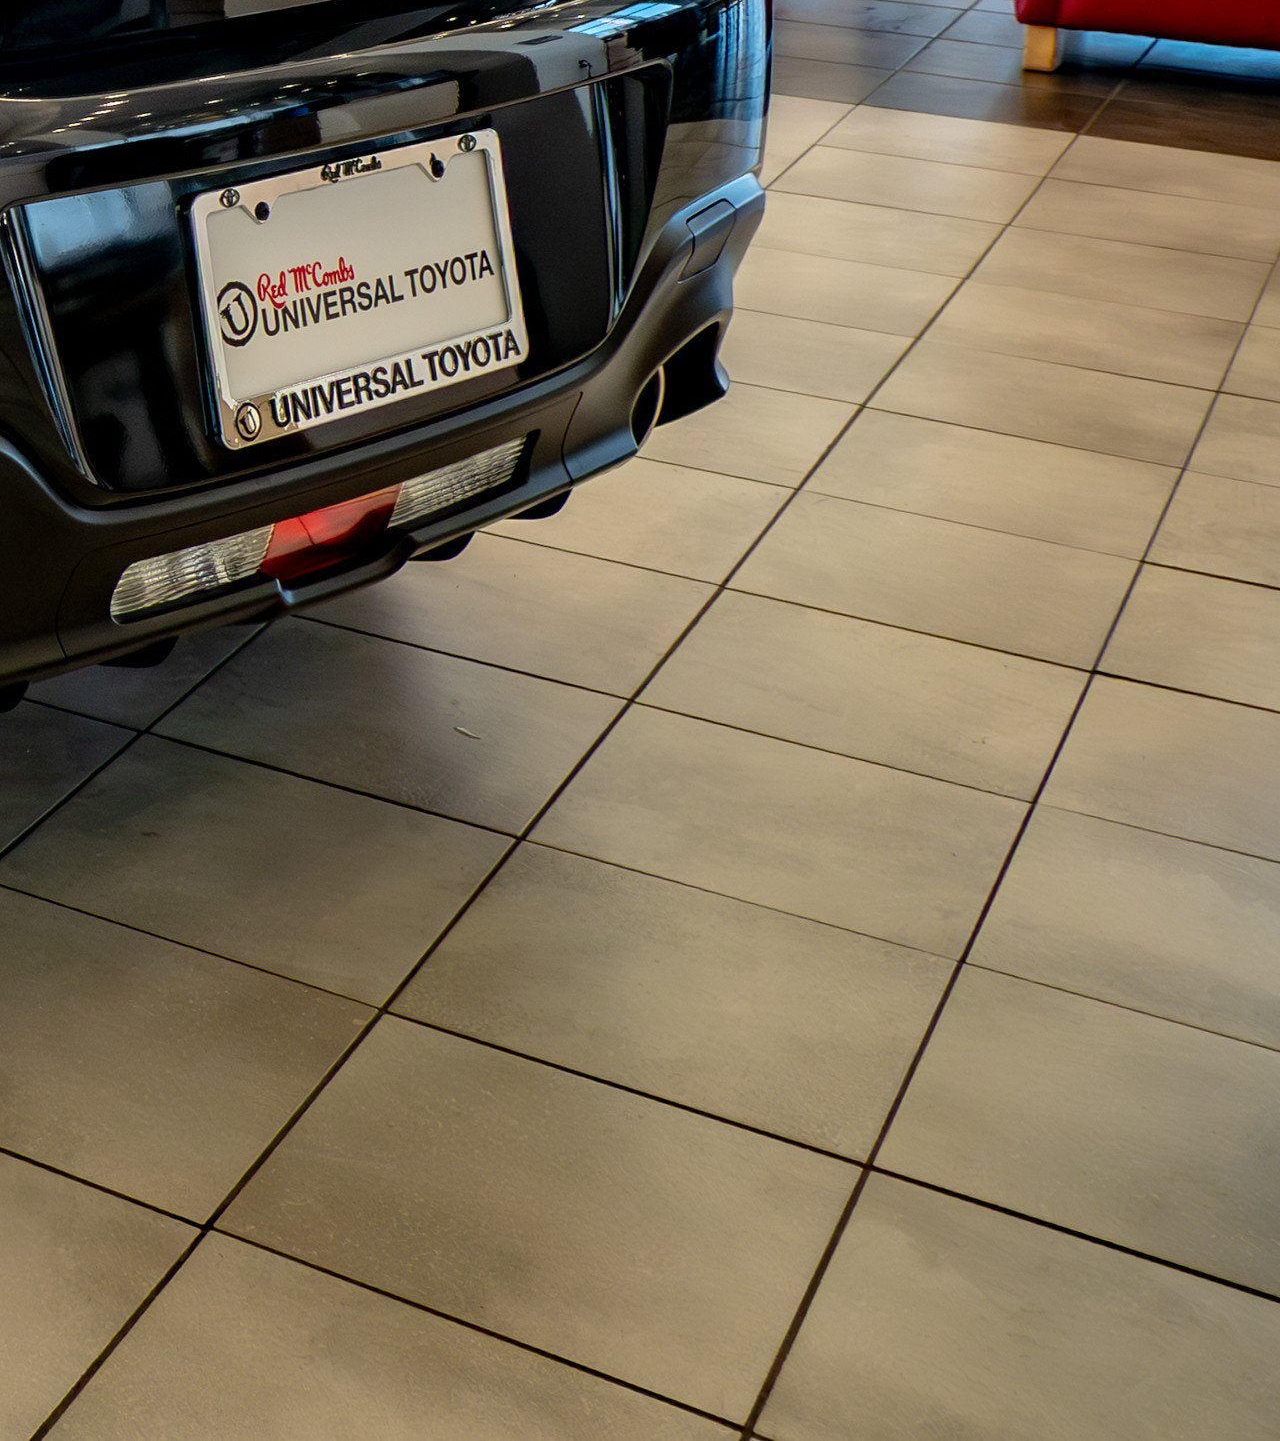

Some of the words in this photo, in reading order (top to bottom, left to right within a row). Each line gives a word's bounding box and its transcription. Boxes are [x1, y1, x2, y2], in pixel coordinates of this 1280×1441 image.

[256, 272, 287, 309] Red
[287, 256, 355, 295] McCombs
[260, 274, 405, 337] UNIVERSAL
[403, 248, 495, 295] TOYOTA
[269, 358, 425, 430] UNIVERSAL
[421, 328, 522, 383] TOYOTA
